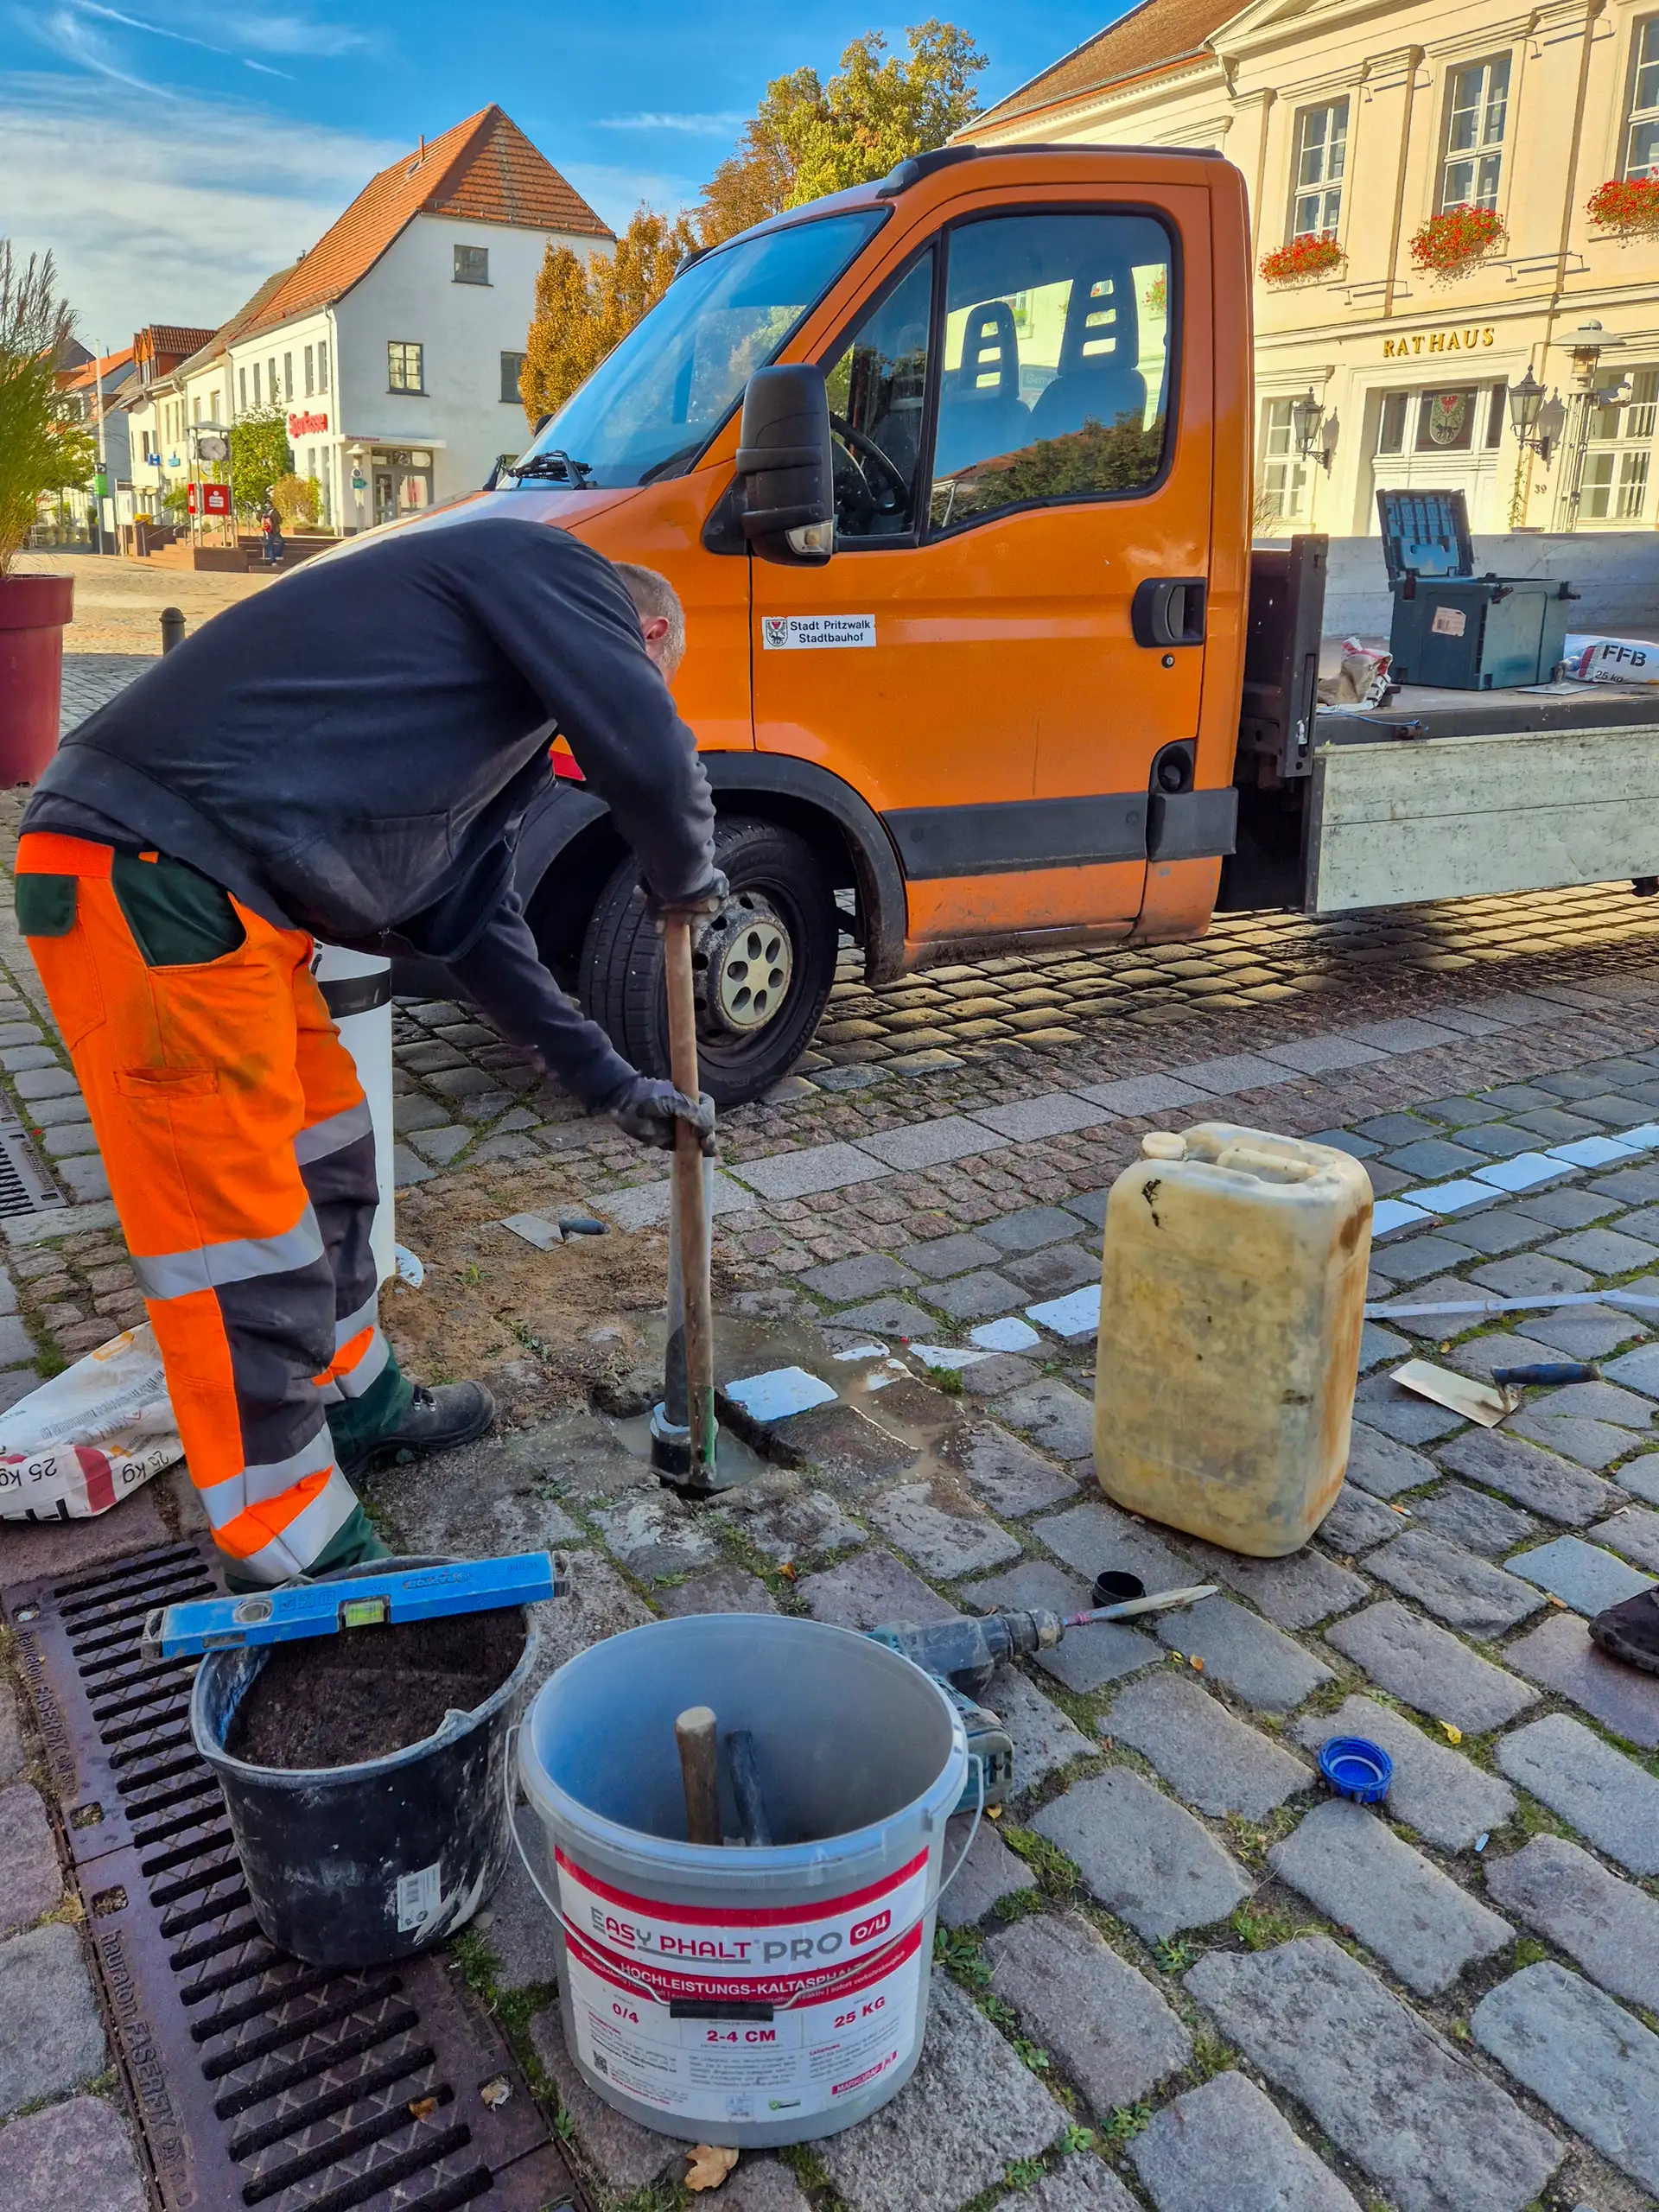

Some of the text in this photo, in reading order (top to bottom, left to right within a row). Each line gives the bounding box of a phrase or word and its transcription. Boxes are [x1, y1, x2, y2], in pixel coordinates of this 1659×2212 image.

[1382, 327, 1495, 358] RATHAUS
[1535, 484, 1547, 494] 39
[790, 620, 871, 632] Stadt Pritzwalk
[798, 632, 864, 644] Stadtbauhof
[1602, 645, 1647, 667] FFB
[1595, 671, 1608, 681] 25
[29, 1458, 58, 1483] 25
[122, 1451, 169, 1484] 25 kg
[590, 1906, 887, 1964] EASY PHALT PRO 0/4
[613, 2003, 639, 2024] 0/4
[835, 2011, 856, 2029] 25
[862, 1996, 886, 2018] KG
[99, 1929, 138, 2018] hauraton
[125, 2018, 177, 2133] FASERFIX
[707, 2030, 776, 2043] 2-4 CM
